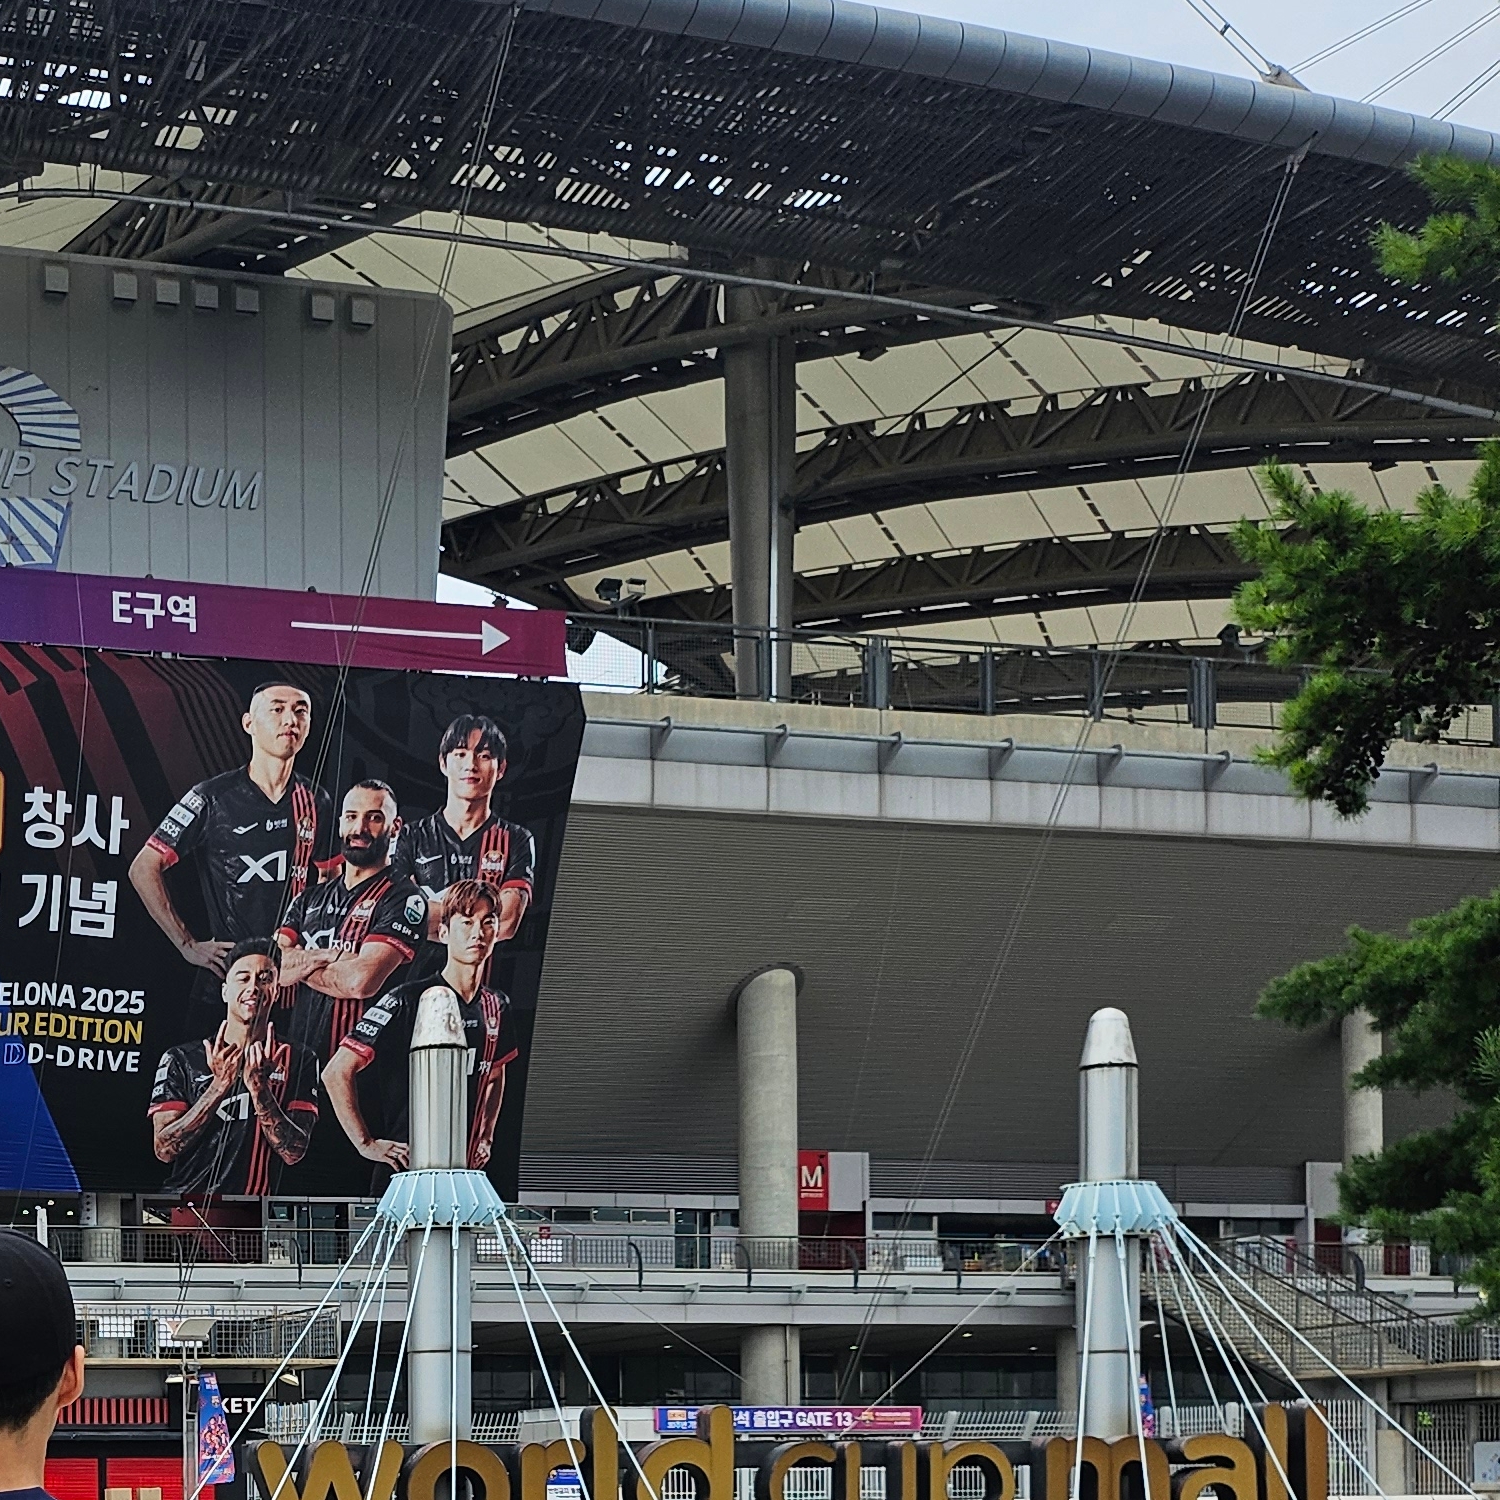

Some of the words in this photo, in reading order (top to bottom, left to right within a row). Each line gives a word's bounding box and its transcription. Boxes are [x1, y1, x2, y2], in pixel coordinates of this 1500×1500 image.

[49, 456, 266, 511] STADIUM
[112, 590, 197, 633] E구역
[22, 786, 130, 855] 창사
[18, 874, 119, 939] 기념
[81, 986, 145, 1015] 2025
[37, 1012, 144, 1046] EDITION
[355, 1021, 380, 1038] GS25
[27, 1045, 141, 1073] D-DRIVE
[801, 1165, 823, 1188] M
[221, 1397, 256, 1414] KET
[753, 1410, 794, 1428] 출입구
[795, 1411, 833, 1427] GATE
[835, 1411, 854, 1427] 13
